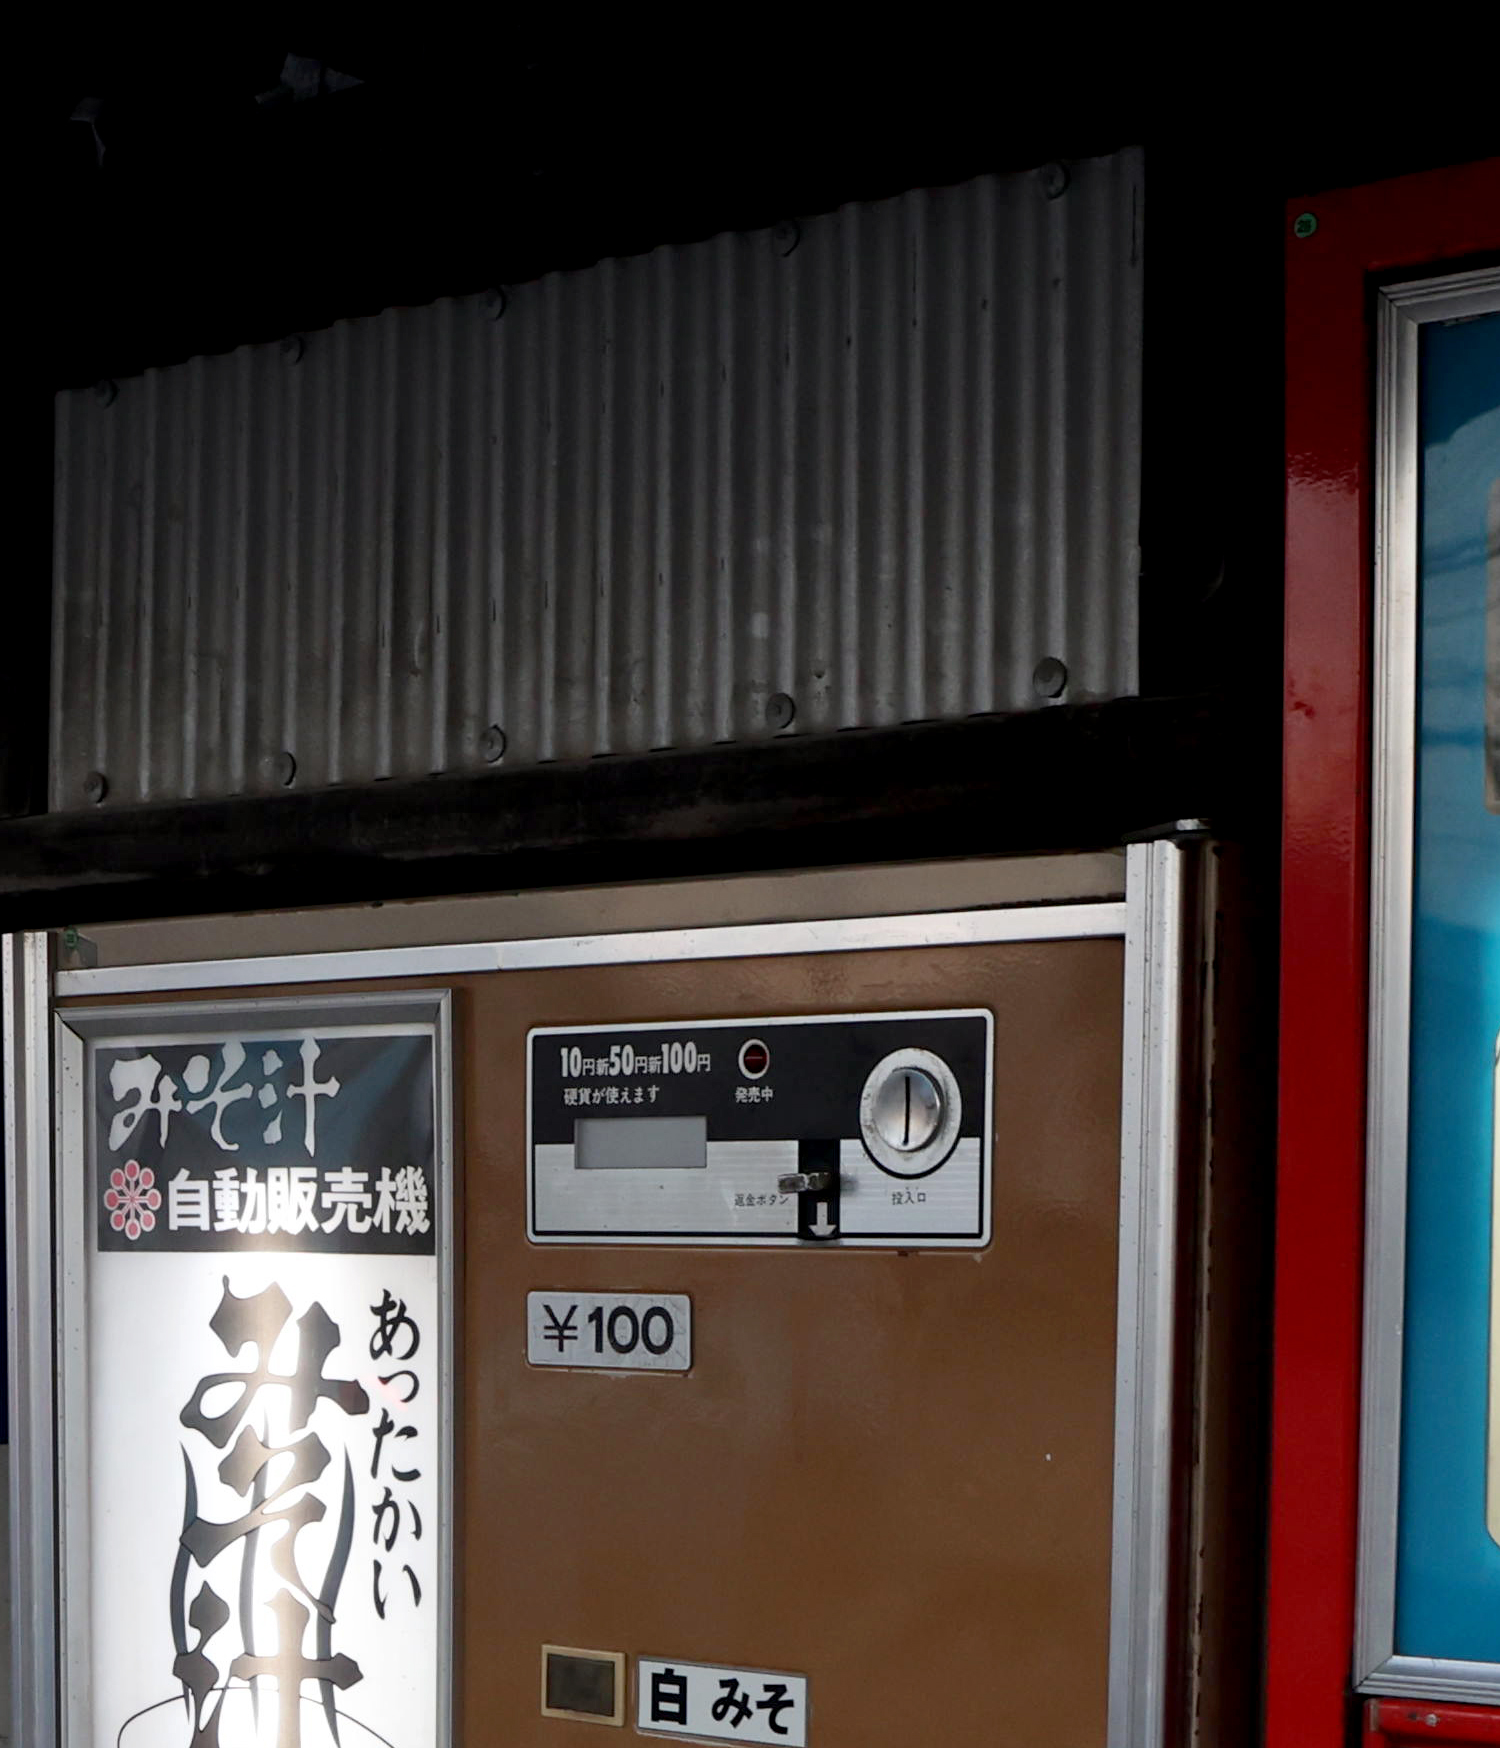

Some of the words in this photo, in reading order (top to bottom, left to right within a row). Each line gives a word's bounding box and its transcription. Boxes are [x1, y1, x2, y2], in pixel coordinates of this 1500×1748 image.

[108, 1037, 341, 1157] みそ汁
[563, 1084, 660, 1106] 硬貨が使えます
[735, 1086, 774, 1103] 発売中
[168, 1166, 431, 1236] 自動販売機
[891, 1191, 927, 1206] 投入口
[543, 1304, 675, 1355] ¥100
[368, 1288, 423, 1621] あったかい
